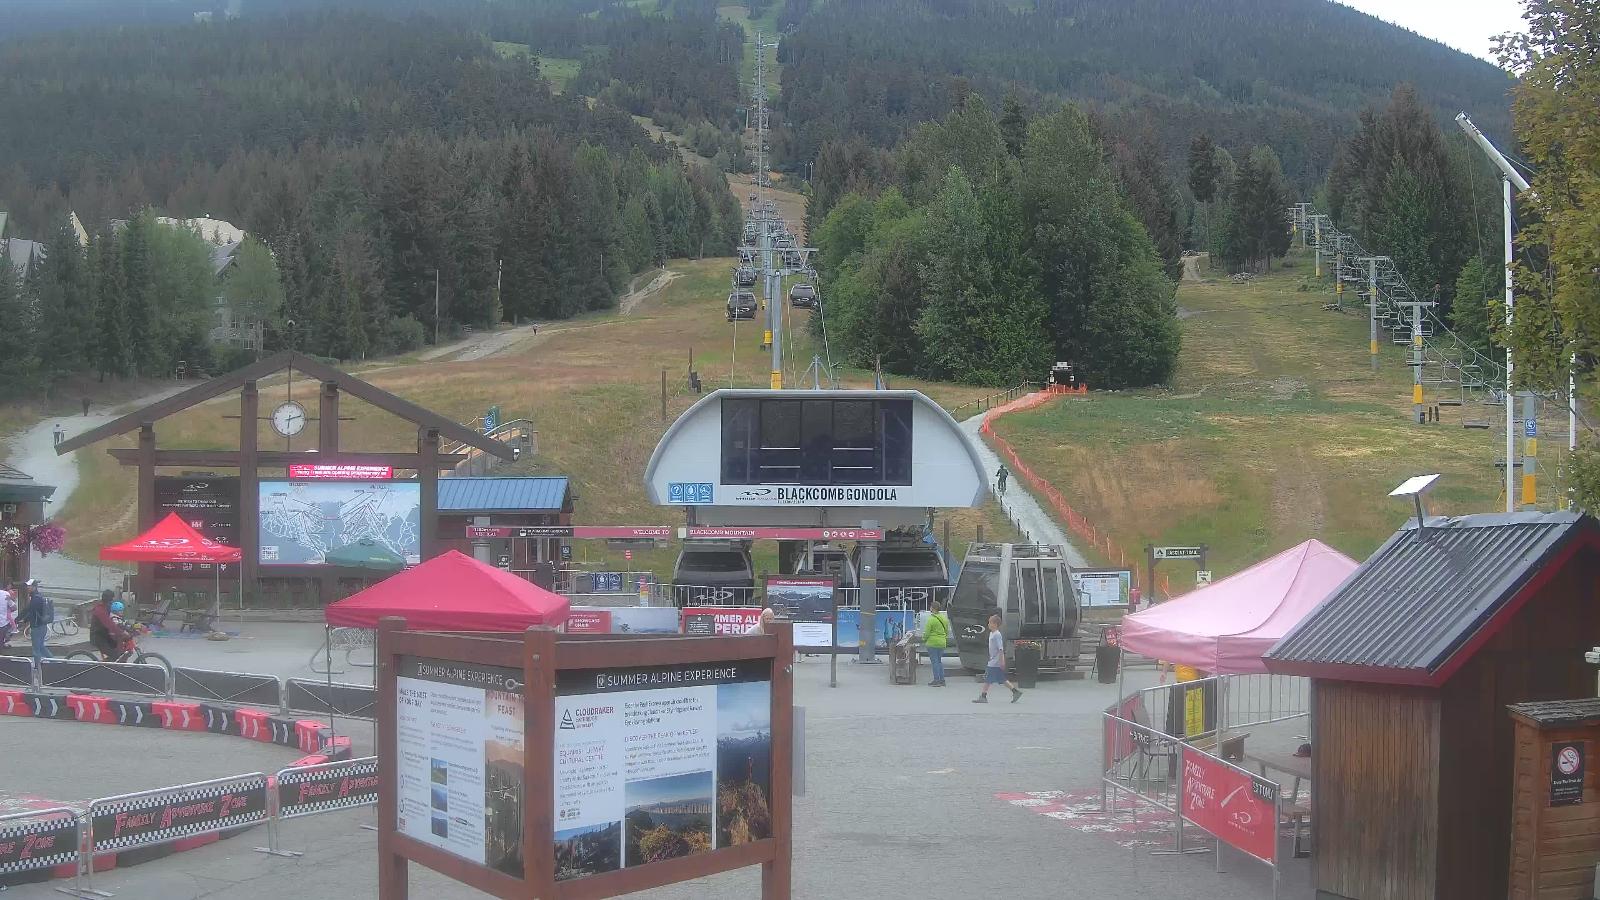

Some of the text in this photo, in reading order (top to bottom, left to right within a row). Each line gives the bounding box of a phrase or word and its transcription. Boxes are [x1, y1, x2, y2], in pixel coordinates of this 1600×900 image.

[777, 487, 897, 501] BLACKCOMB GONDOLA
[422, 665, 503, 685] SUMMER ALPINE EXPERIENCE
[607, 667, 737, 686] SUMMER ALPINE EXPERIENCE
[497, 704, 517, 716] FEAST
[575, 706, 614, 717] CLOUDRAKER
[1184, 759, 1206, 780] FAMILY
[298, 781, 336, 804] FAMILY
[1186, 776, 1216, 800] ADVENTURE
[1190, 792, 1205, 810] ZONE
[113, 793, 248, 838] FAMILY ADVENTURE ZONE
[20, 832, 56, 860] ZONE
